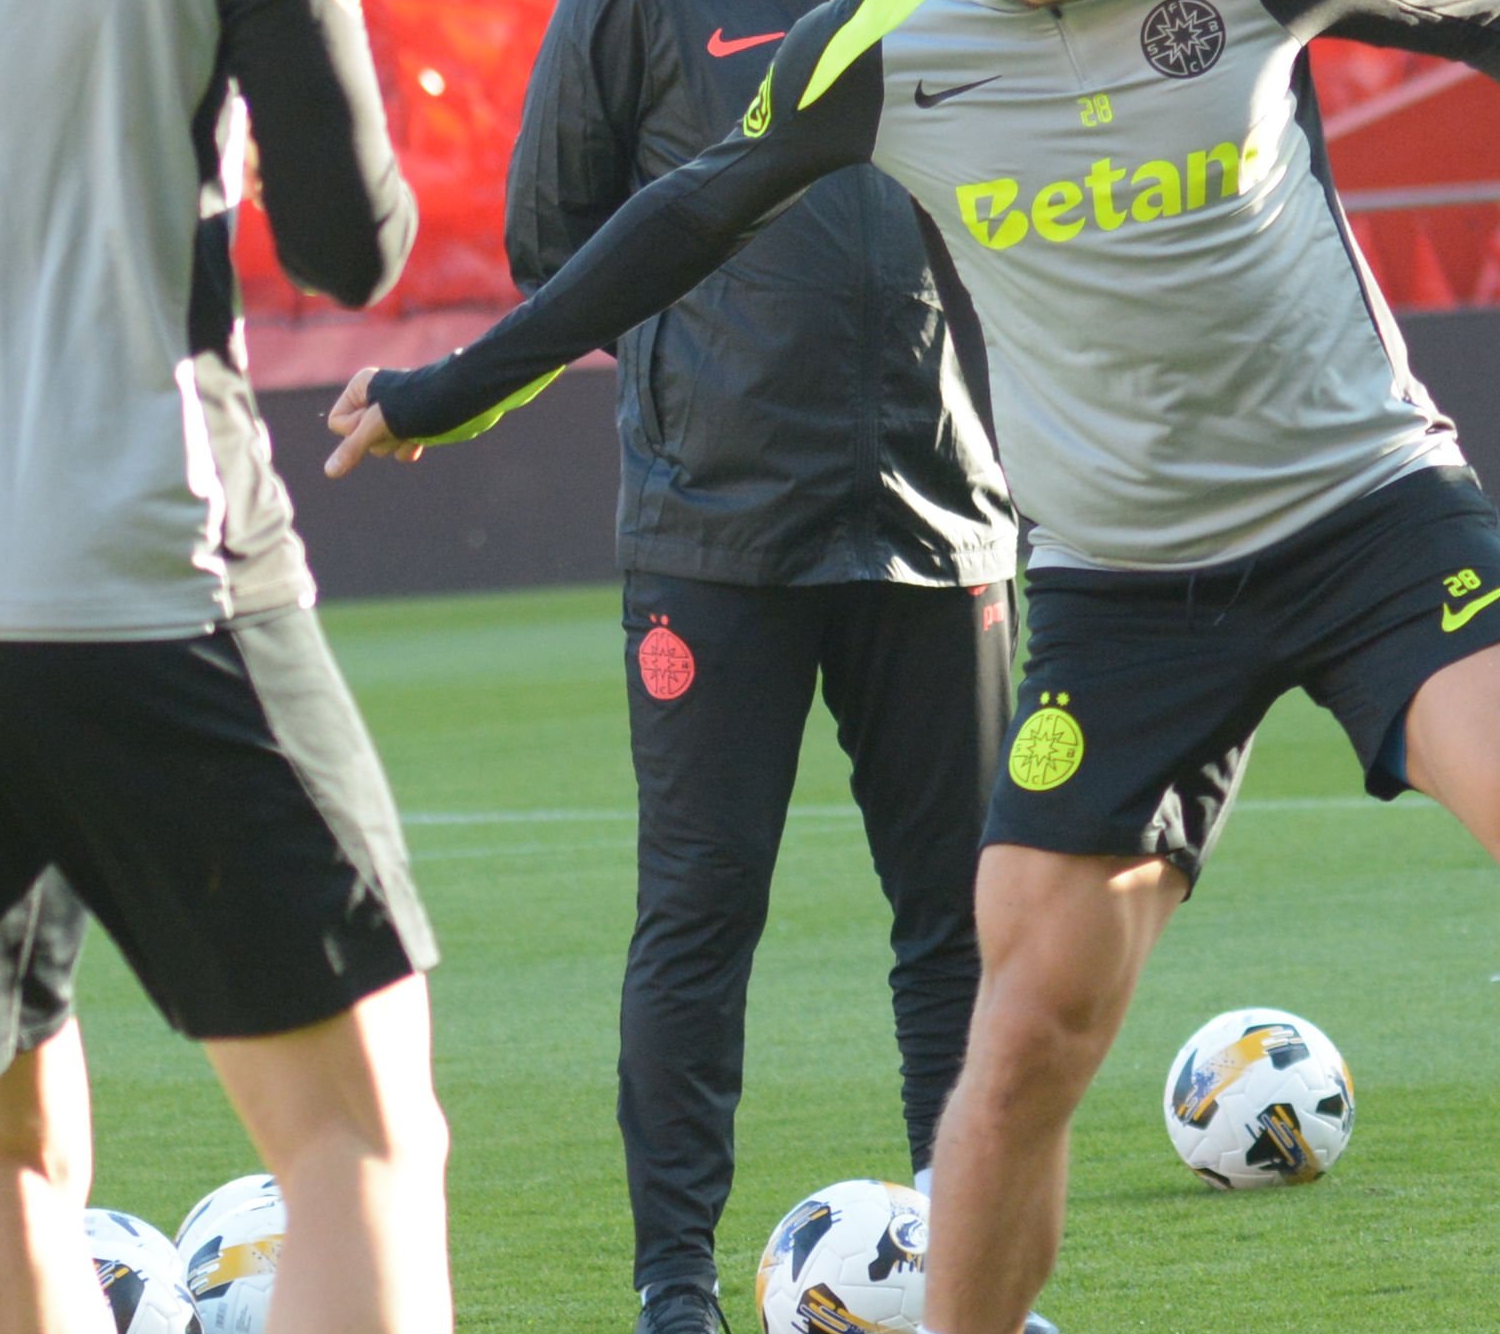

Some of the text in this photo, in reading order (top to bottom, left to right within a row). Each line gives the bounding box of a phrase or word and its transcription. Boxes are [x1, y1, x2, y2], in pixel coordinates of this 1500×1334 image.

[1076, 93, 1114, 128] 28
[955, 141, 1258, 250] Betan
[1443, 569, 1481, 598] 28
